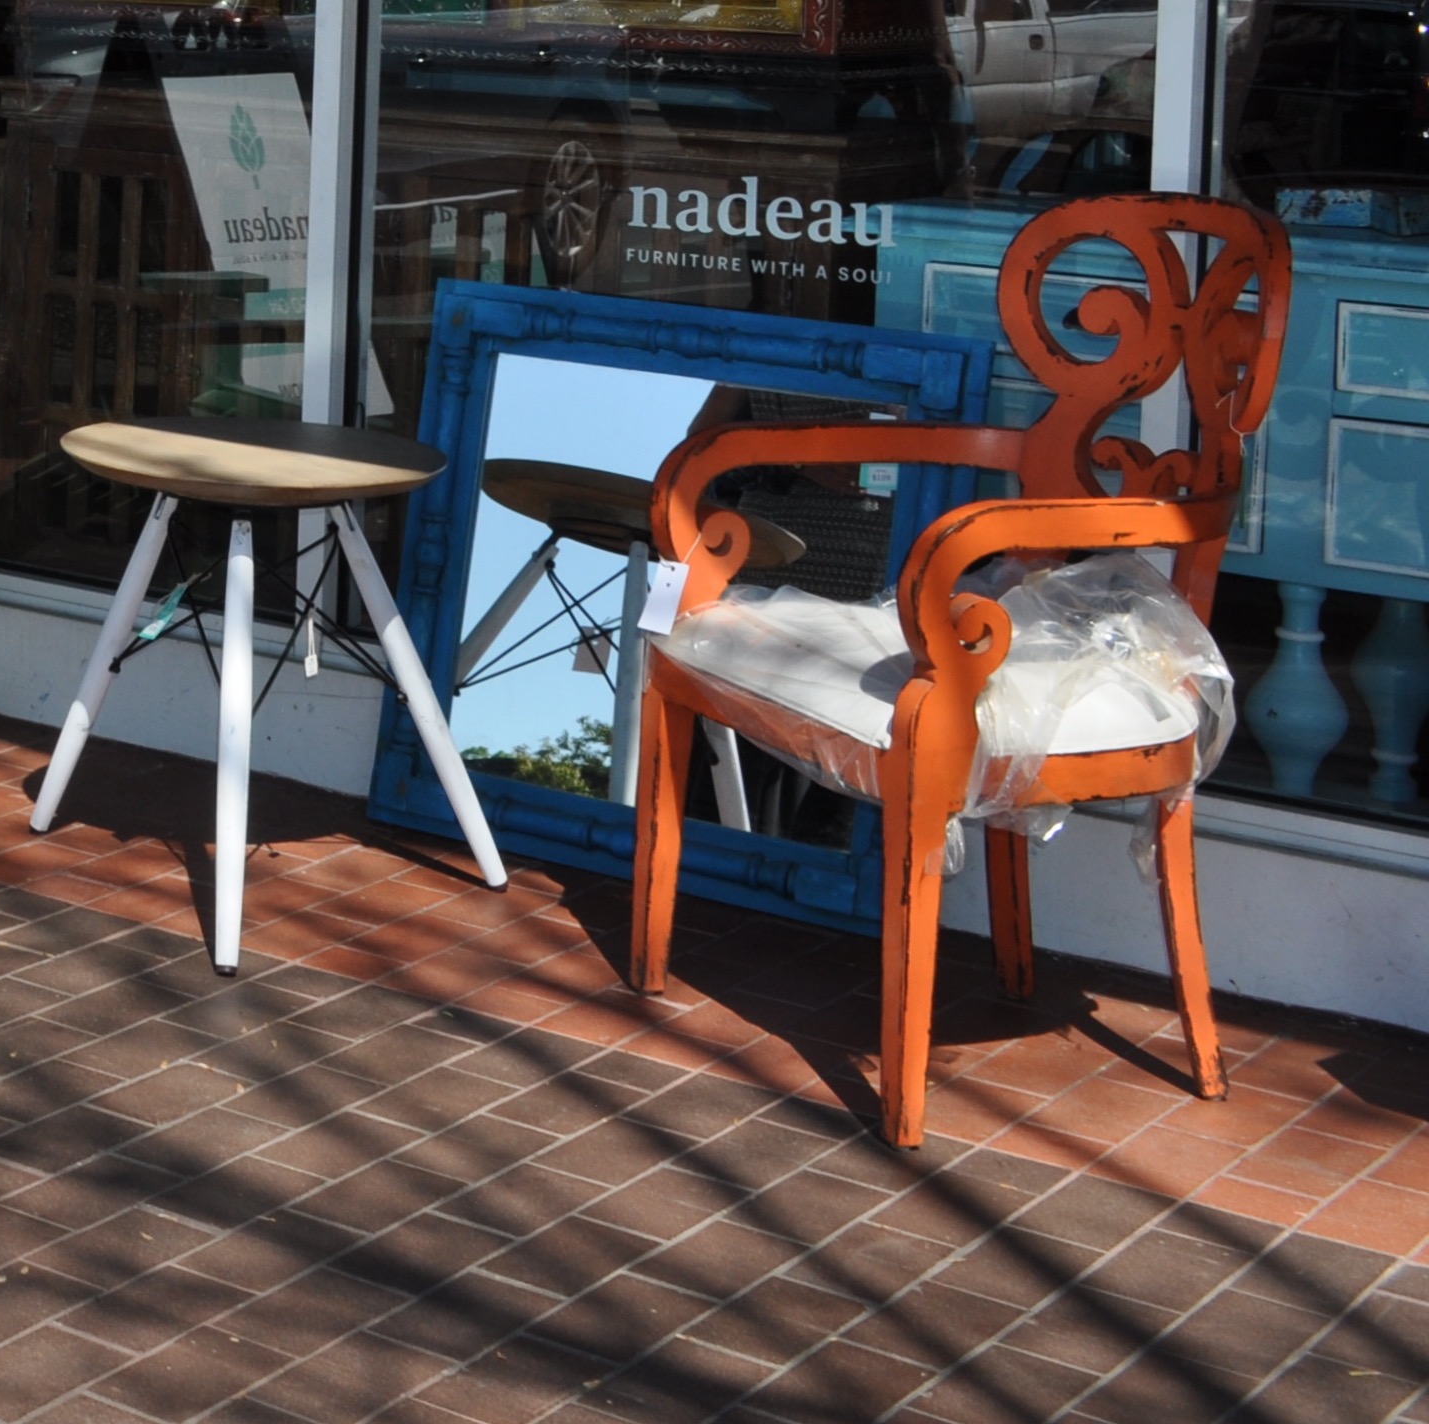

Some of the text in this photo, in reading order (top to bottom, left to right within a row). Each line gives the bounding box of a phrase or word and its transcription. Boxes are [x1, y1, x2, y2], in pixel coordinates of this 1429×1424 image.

[627, 175, 898, 249] nadeau
[625, 247, 743, 273] FURNITURE
[750, 258, 806, 278] WITH
[815, 263, 828, 280] A
